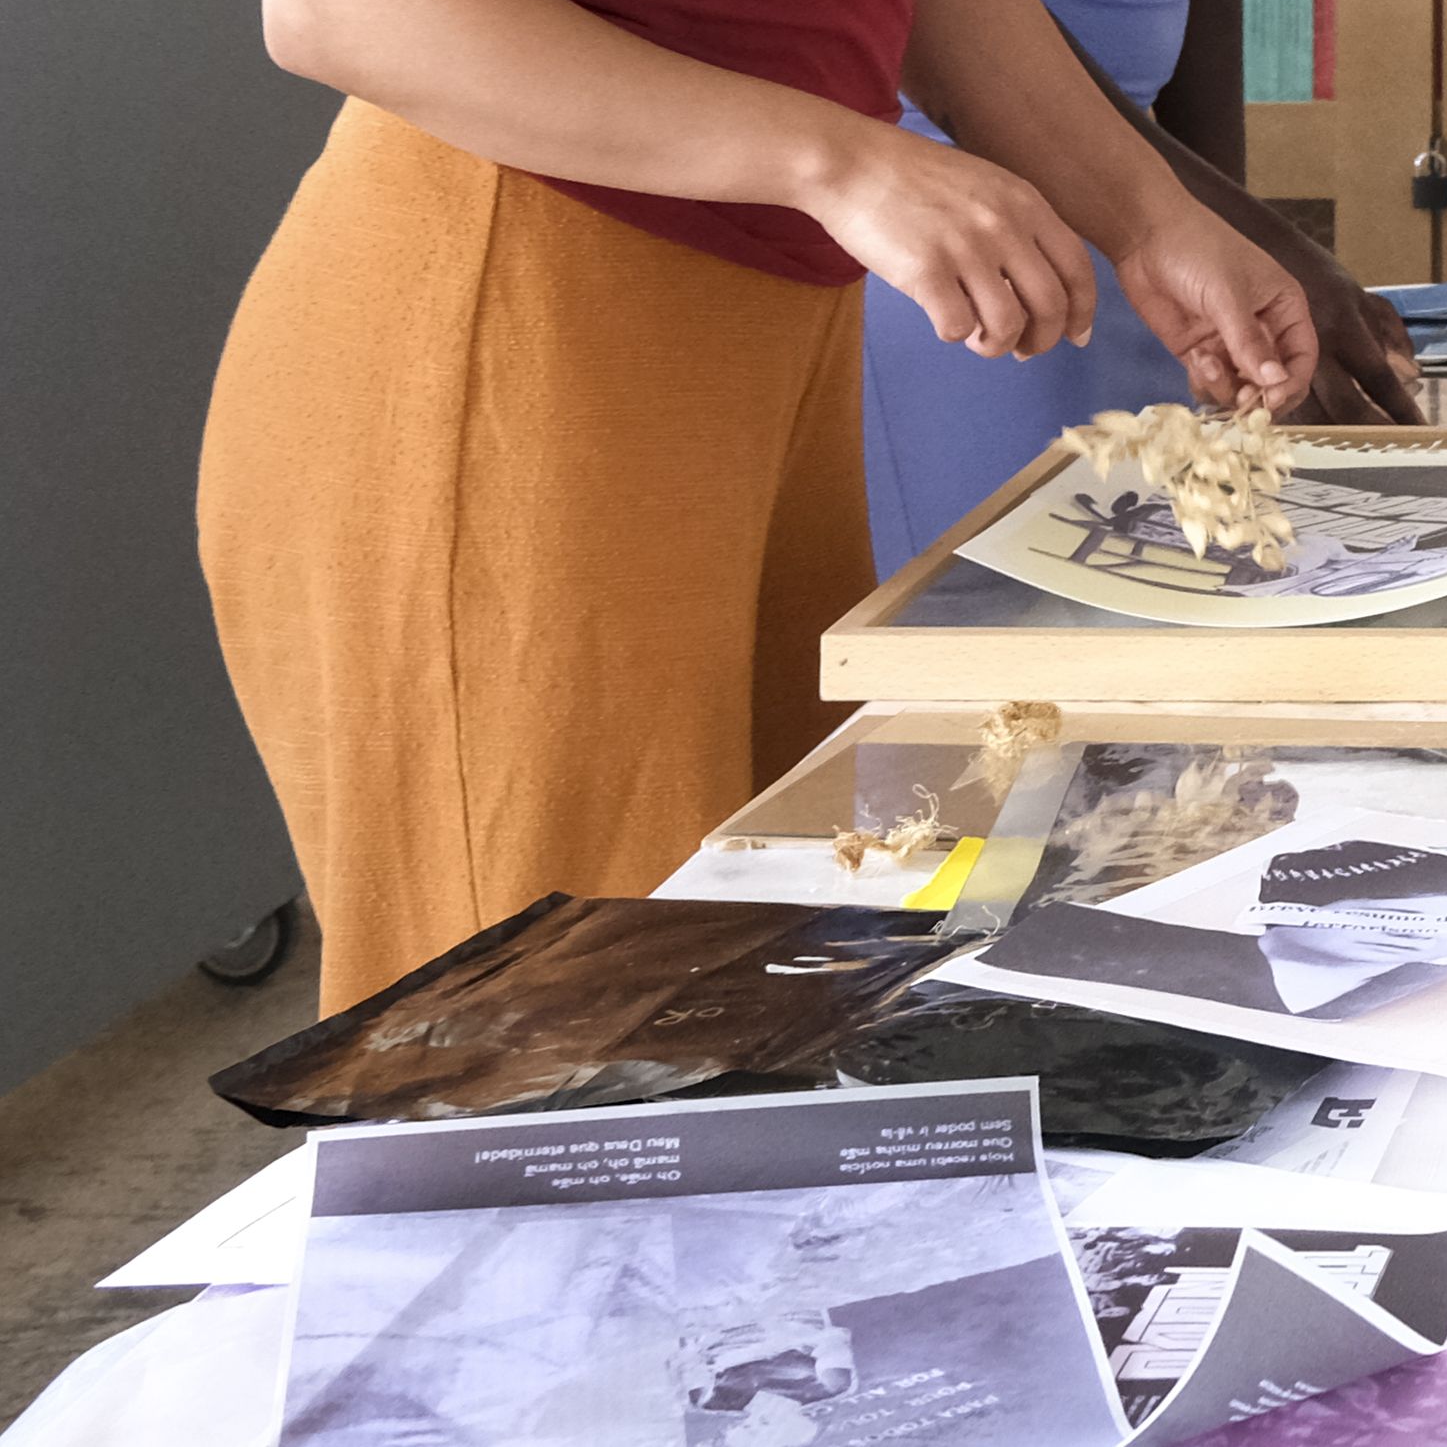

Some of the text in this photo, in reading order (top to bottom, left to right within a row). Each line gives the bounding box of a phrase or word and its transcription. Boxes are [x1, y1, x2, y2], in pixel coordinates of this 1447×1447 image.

[935, 1121, 975, 1134] poder
[980, 1119, 1012, 1131] Sem
[925, 1139, 978, 1151] morreu
[982, 1137, 1013, 1148] Que
[474, 1137, 680, 1163] Meu Deus que eternidade!
[875, 1144, 921, 1155] minha
[895, 1158, 927, 1167] uma
[931, 1155, 975, 1166] recebi
[979, 1152, 1014, 1162] Hoje
[576, 1159, 599, 1171] oh
[588, 1175, 611, 1185] oh
[656, 1170, 681, 1181] Oh
